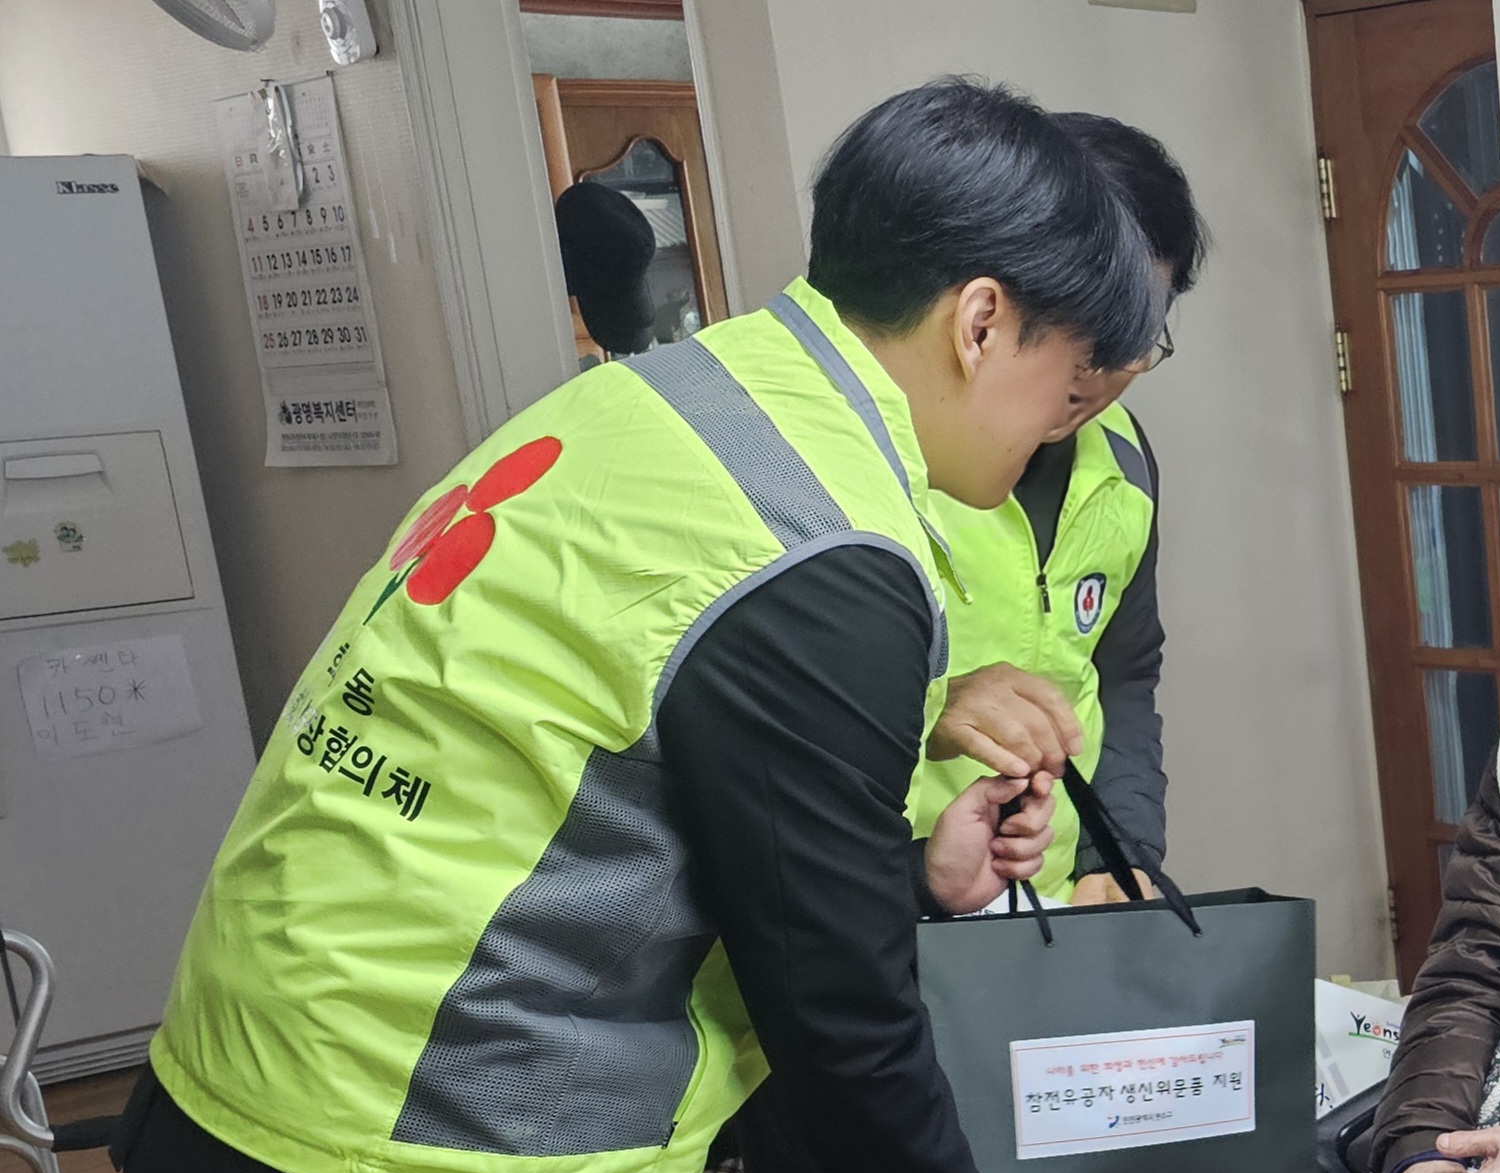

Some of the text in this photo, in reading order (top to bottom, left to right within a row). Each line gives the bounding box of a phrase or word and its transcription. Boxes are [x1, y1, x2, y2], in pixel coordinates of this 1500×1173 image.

[312, 164, 335, 184] 2 3
[247, 205, 345, 232] 4 5 6 7 8 9 10
[252, 245, 351, 272] 11 12 13 14 15 16 17
[257, 286, 359, 311] 18 19 20 21 22 23 24
[263, 326, 368, 349] 25 26 27 28 29 30 31
[291, 400, 358, 424] 광명복지센터
[1026, 1071, 1243, 1113] 참전유공자 생신위문품 지원
